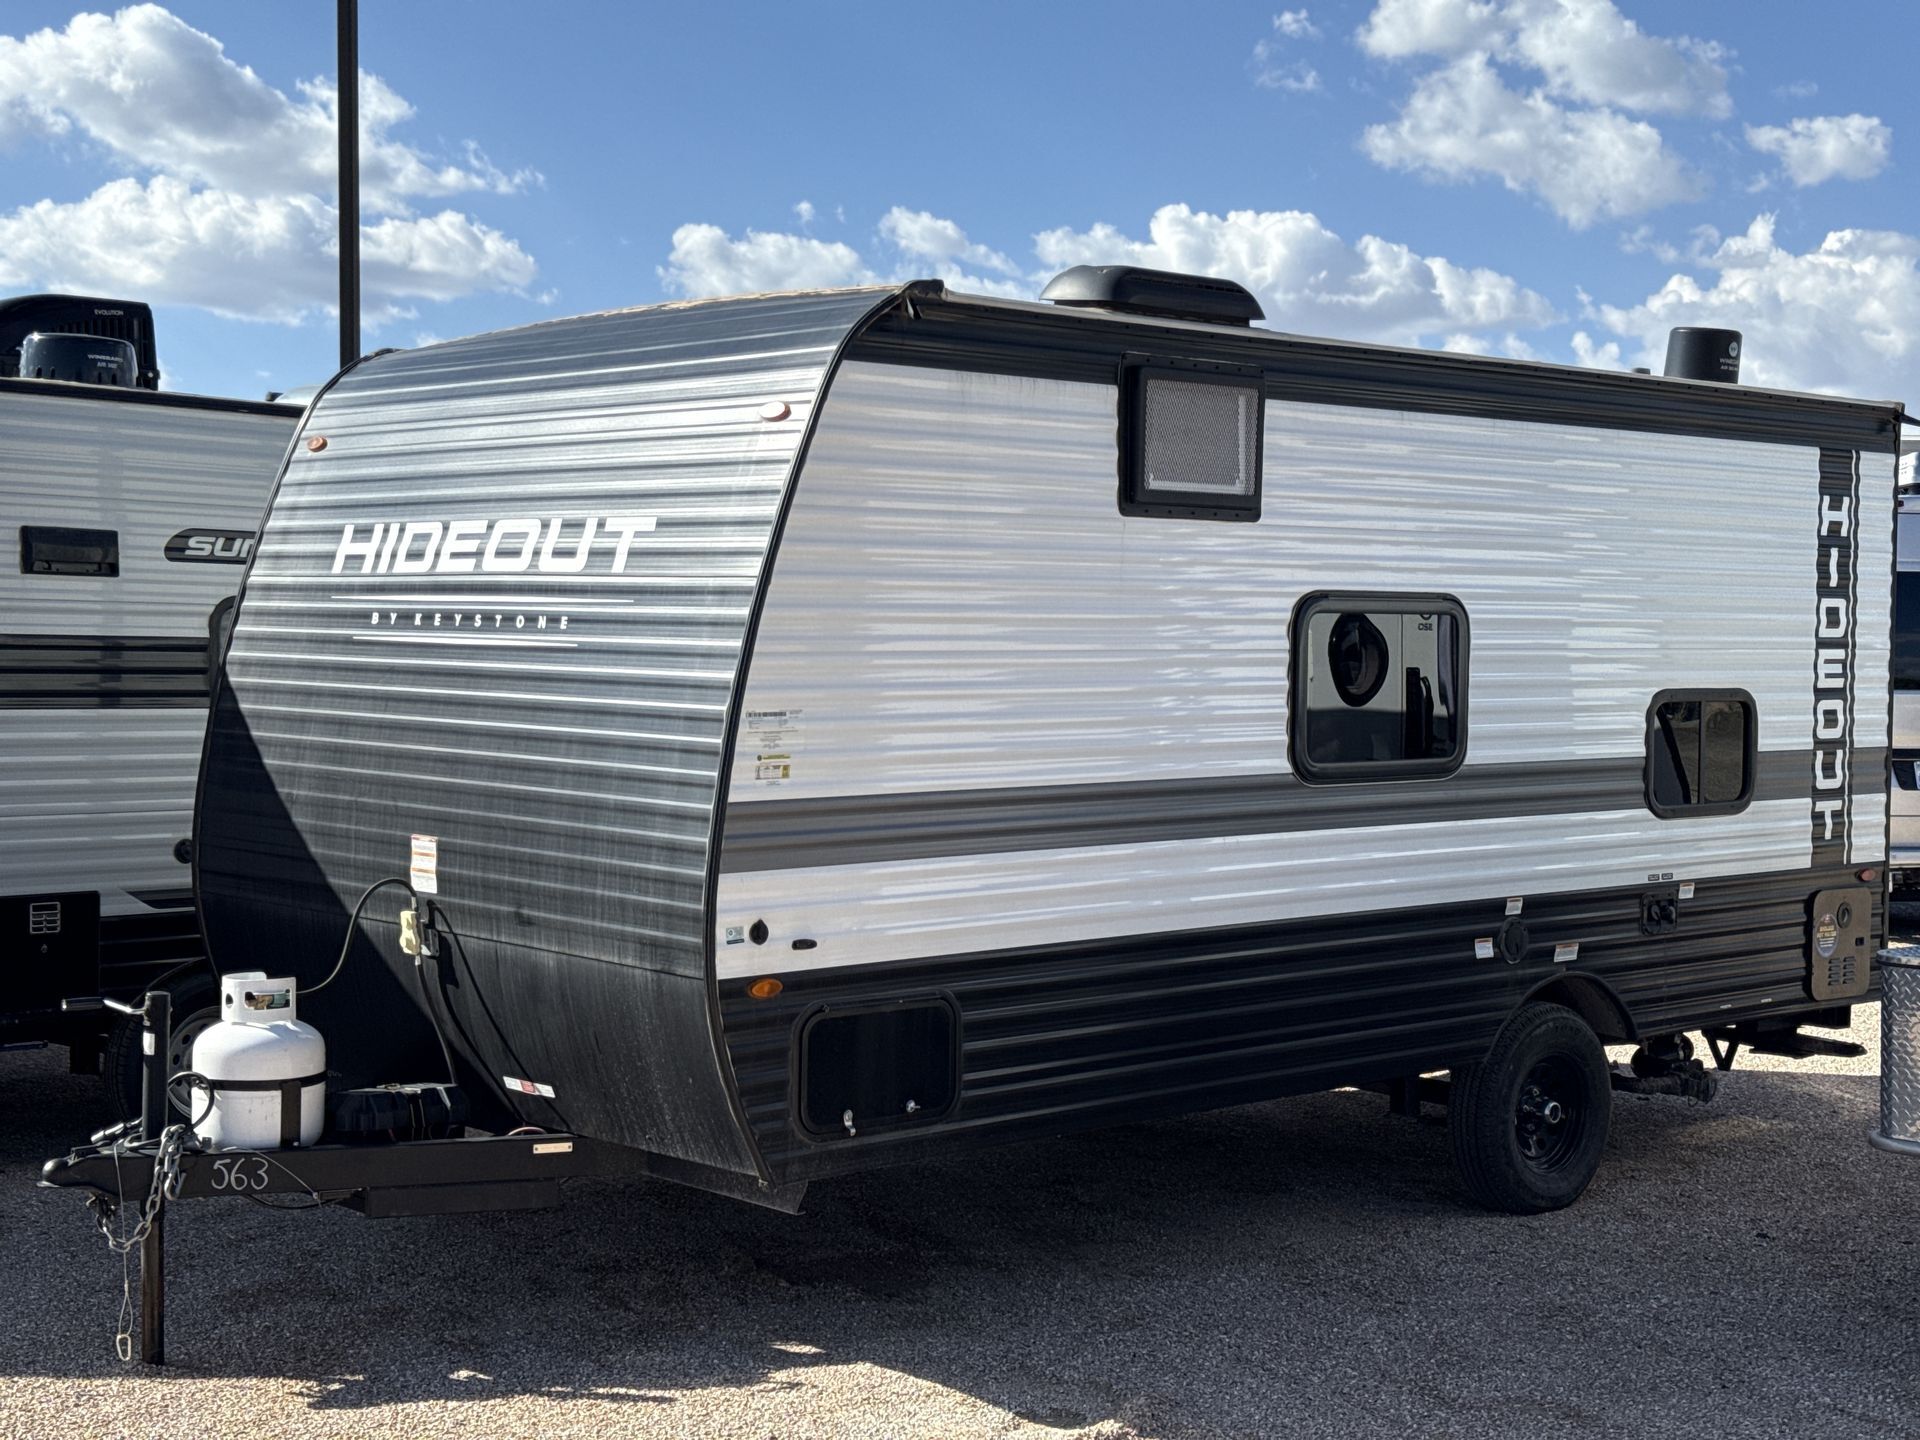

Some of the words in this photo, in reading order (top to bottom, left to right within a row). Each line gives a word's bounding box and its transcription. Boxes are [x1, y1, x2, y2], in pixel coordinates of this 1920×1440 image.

[331, 516, 657, 574] HIDEOUT
[371, 611, 398, 625] BY
[413, 612, 569, 630] KEYSTONE
[1814, 495, 1850, 840] HIDEOUT
[211, 1157, 269, 1191] 563
